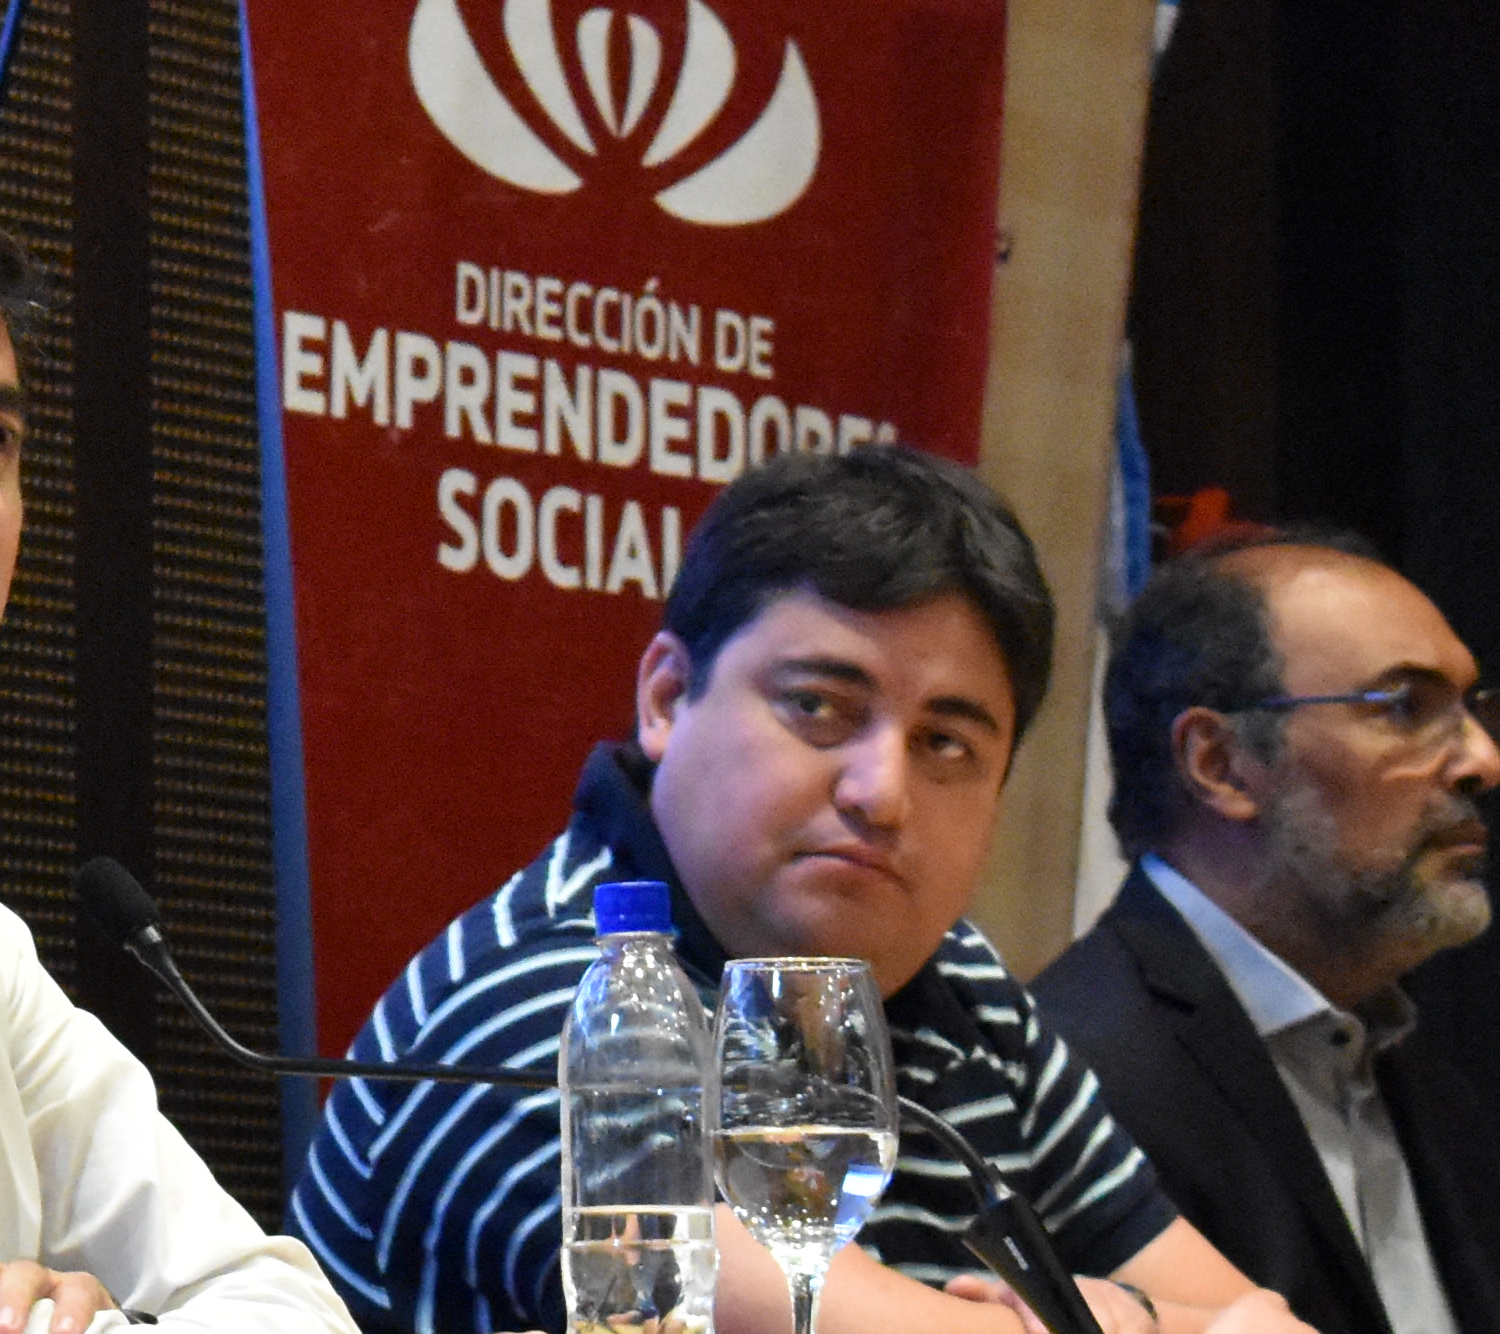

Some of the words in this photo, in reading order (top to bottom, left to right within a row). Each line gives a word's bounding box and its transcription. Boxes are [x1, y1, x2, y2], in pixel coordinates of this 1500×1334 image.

[456, 261, 701, 366] DIRECCIÓN
[715, 310, 775, 379] DE
[281, 310, 896, 485] EMPRENDEDOR
[438, 467, 683, 600] SOCIAL
